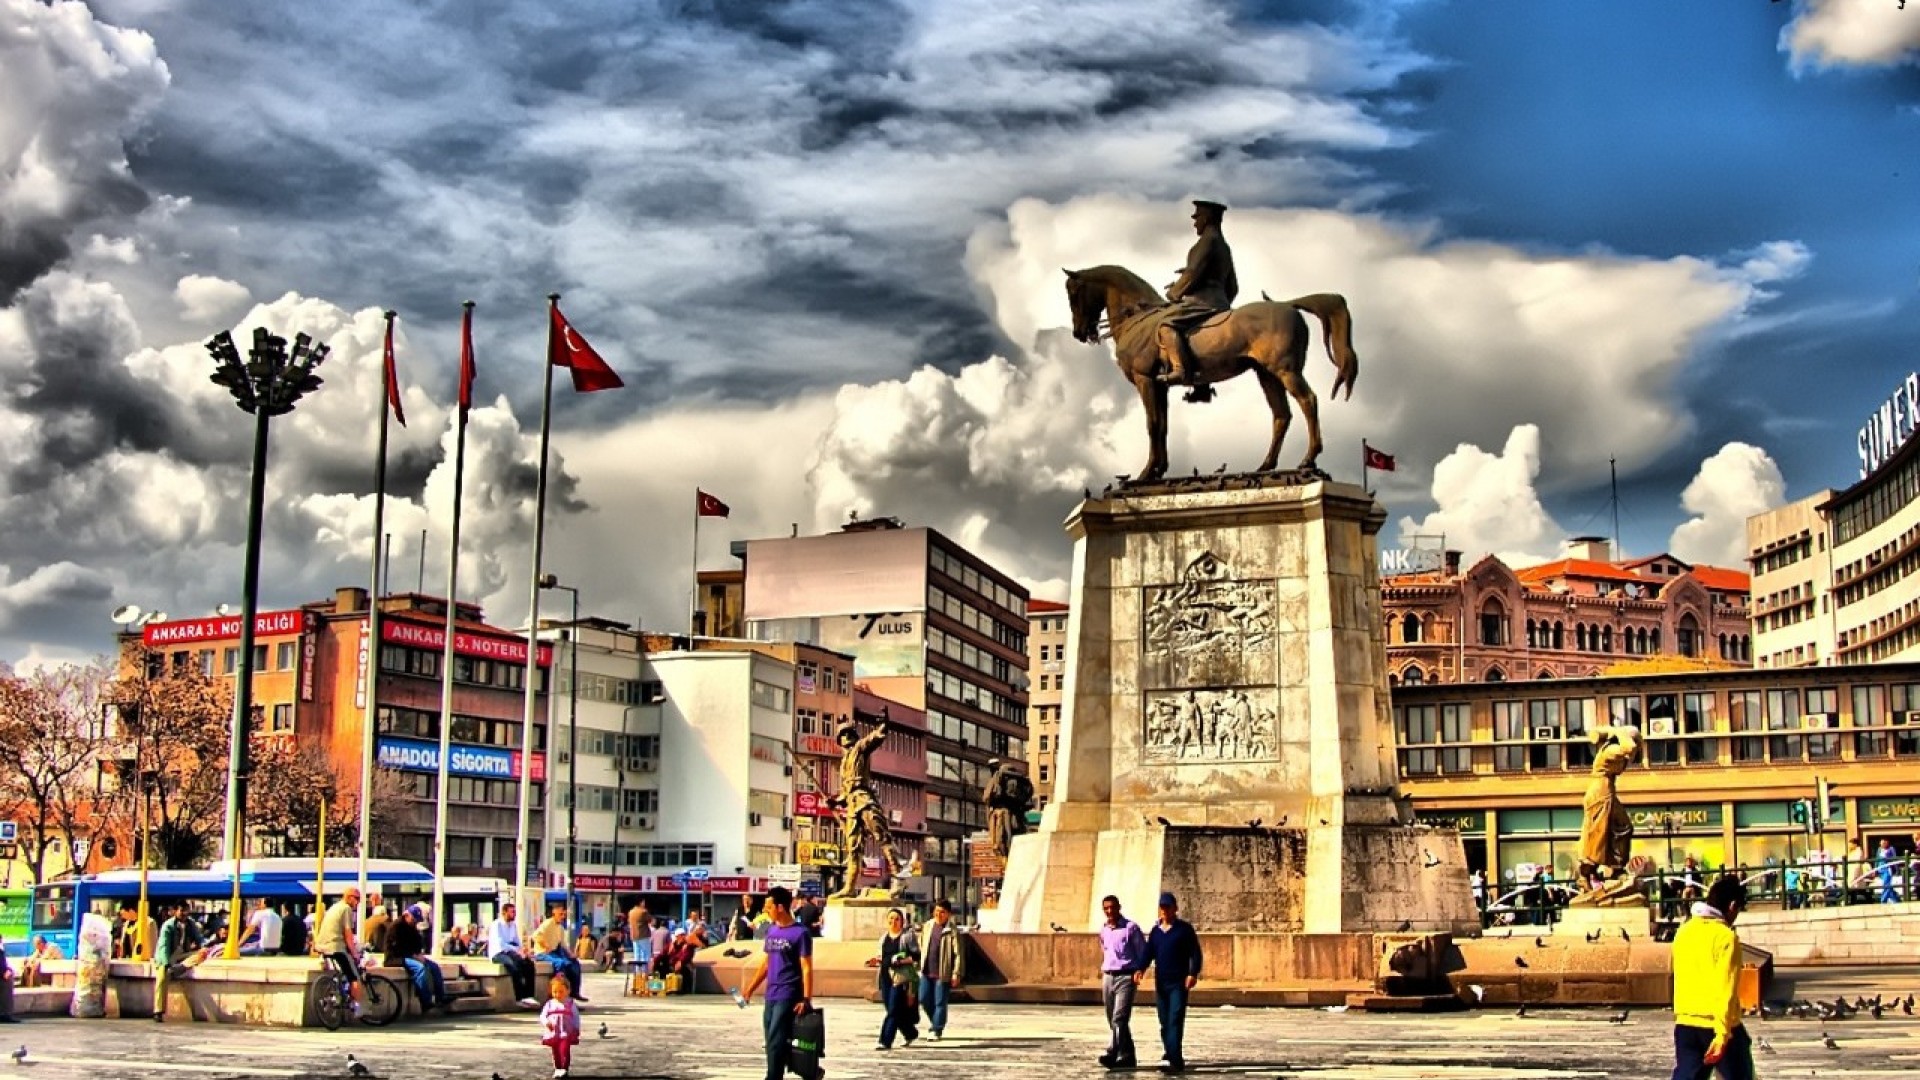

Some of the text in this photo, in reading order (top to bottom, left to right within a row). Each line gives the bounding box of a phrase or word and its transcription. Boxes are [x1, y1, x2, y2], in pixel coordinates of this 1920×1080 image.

[152, 612, 294, 641] ANKARA 3. NORLİĞİ
[878, 621, 912, 635] ULUS
[456, 636, 469, 649] 3.
[302, 633, 315, 700] NOTER
[378, 745, 442, 767] ANADOL
[452, 748, 510, 773] SİGORTA
